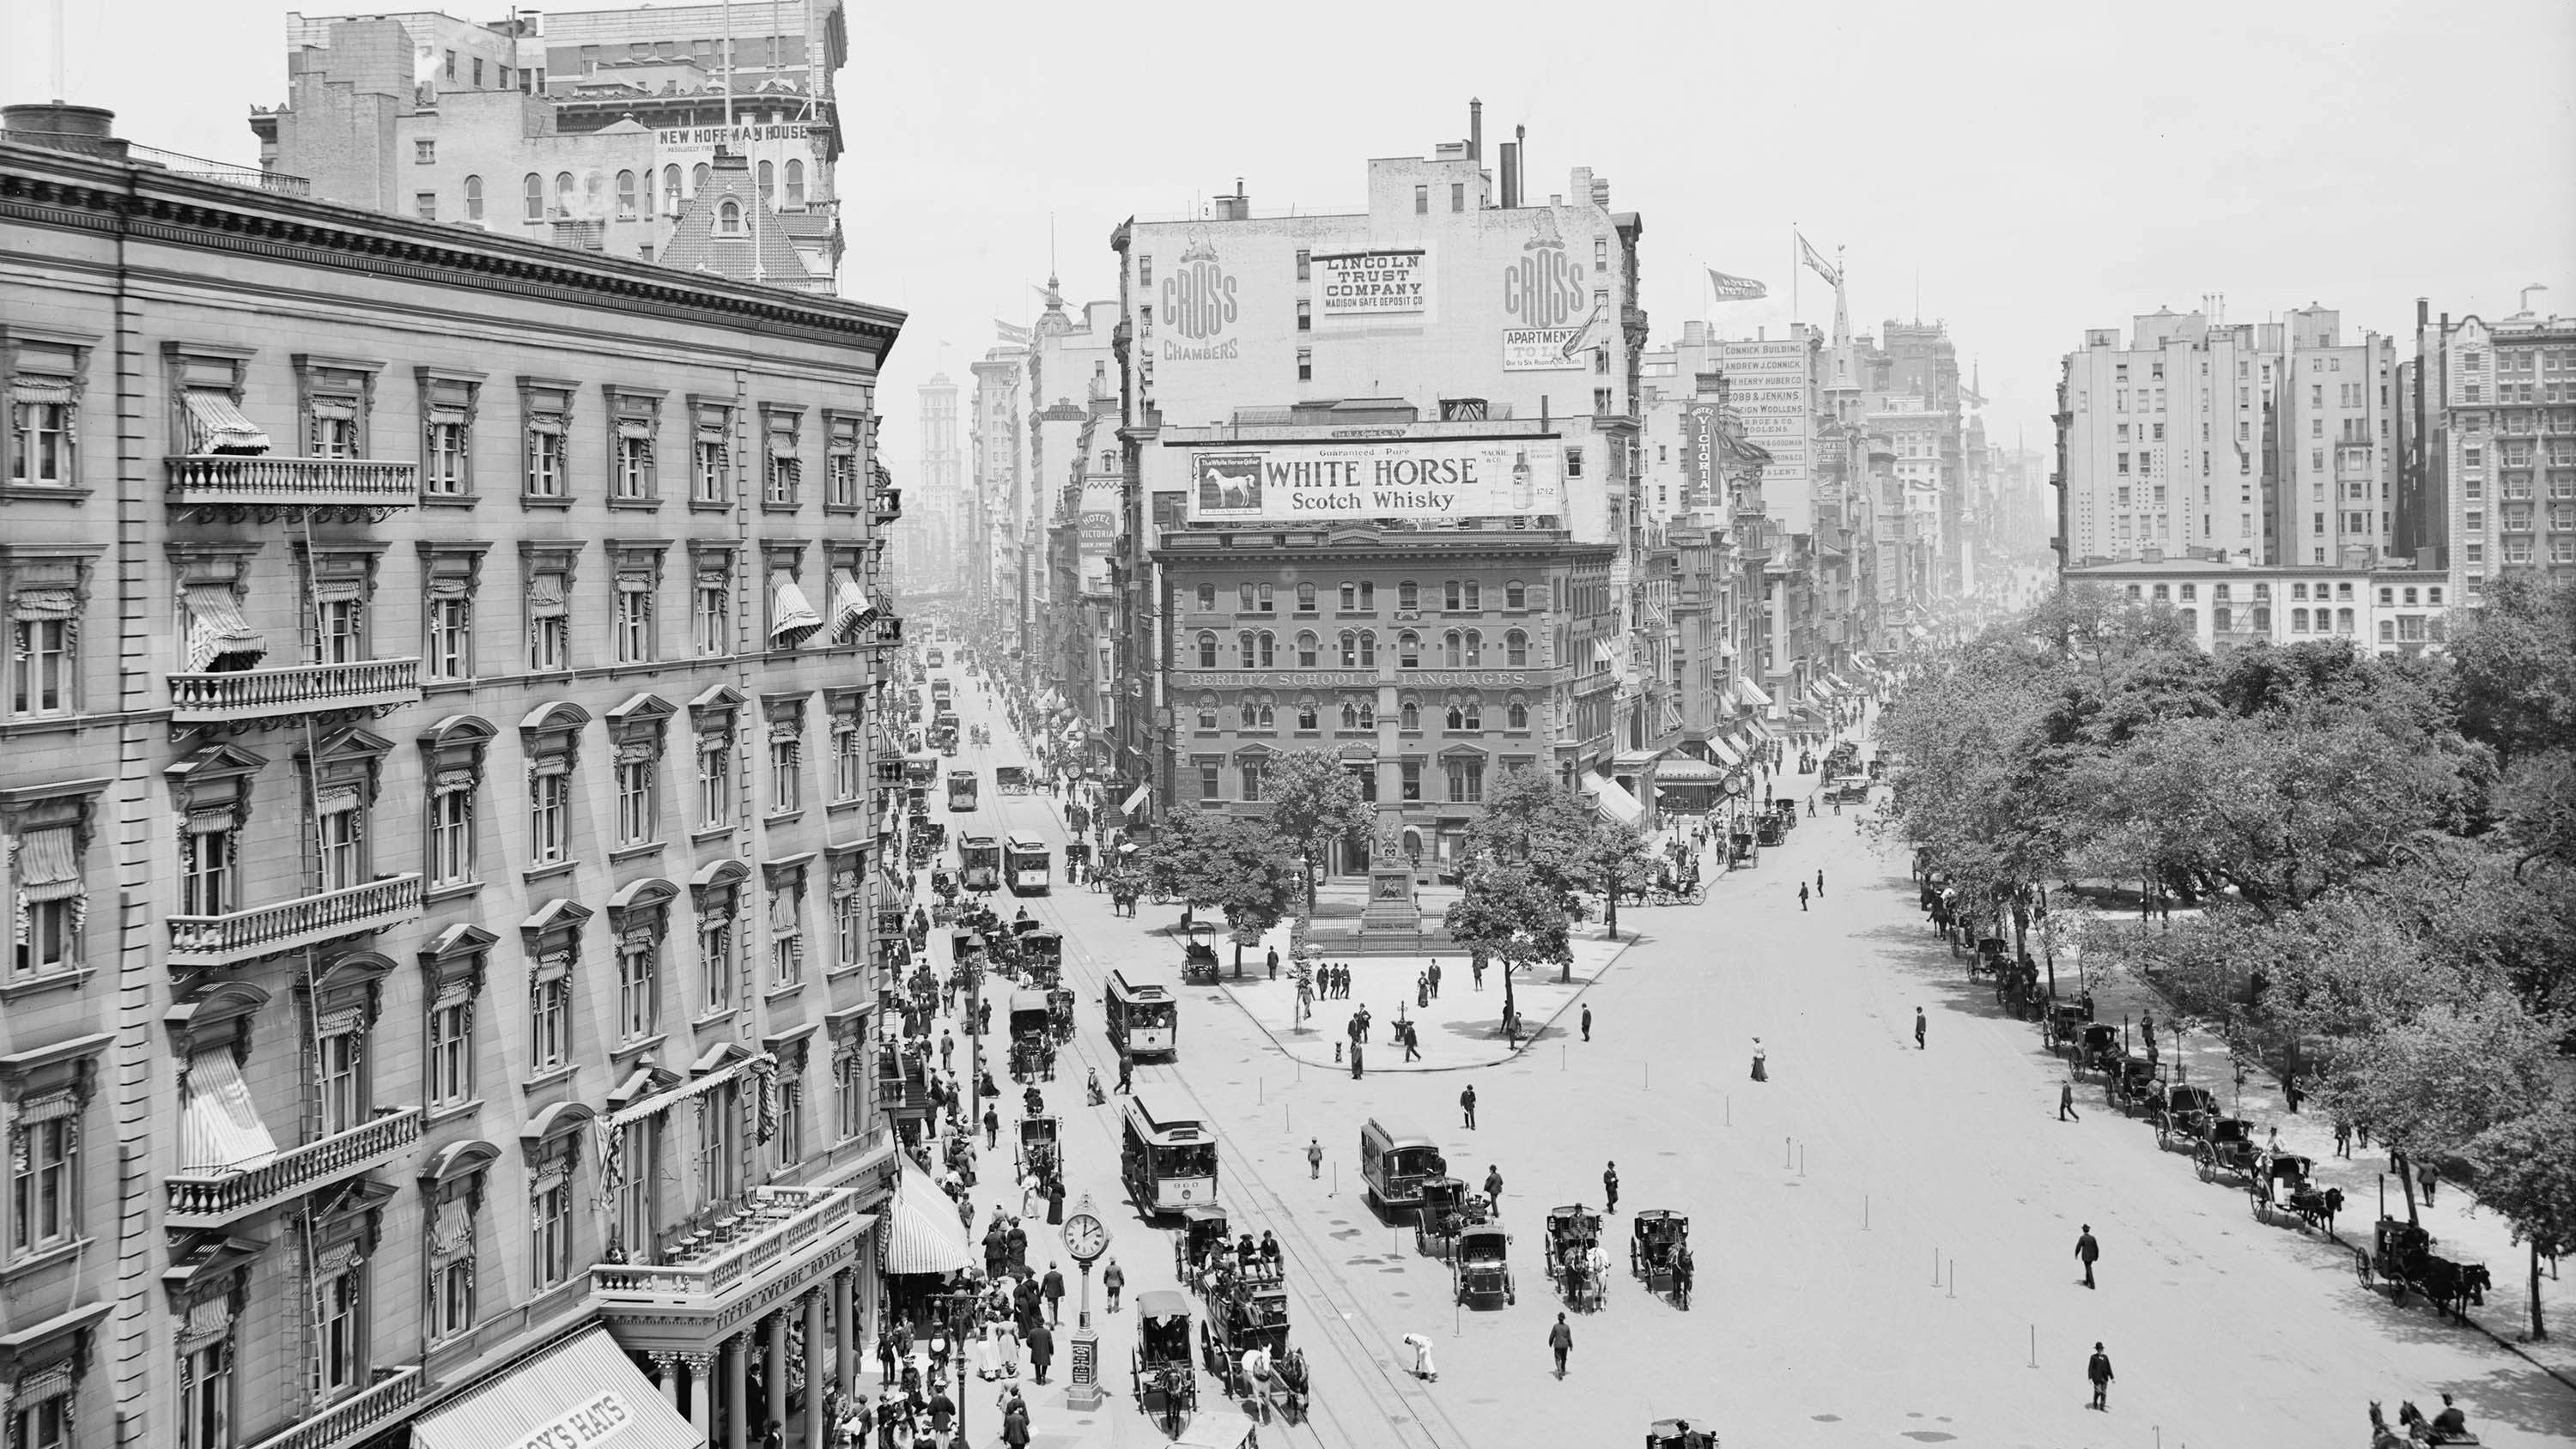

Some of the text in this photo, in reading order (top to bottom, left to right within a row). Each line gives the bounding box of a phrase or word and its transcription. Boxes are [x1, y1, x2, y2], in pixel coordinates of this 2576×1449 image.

[660, 125, 807, 144] NEW HOFFMAN HOUSE
[1327, 256, 1420, 270] LINCOLN
[1338, 269, 1410, 283] TRUST
[1327, 282, 1422, 297] COMPANY
[1504, 248, 1584, 328] CROSS
[1162, 260, 1237, 340] CROSS
[1326, 298, 1357, 308] MADISON
[1359, 297, 1378, 306] SAFE
[1380, 296, 1411, 306] DEPOSIT
[1507, 330, 1577, 344] APARTMENT
[1163, 337, 1238, 361] CHAMBERS
[1515, 346, 1536, 357] TO
[1725, 345, 1759, 355] CONNICK
[1739, 377, 1764, 385] HENRY
[1765, 376, 1790, 385] HUBER
[1753, 391, 1759, 401] &
[1760, 404, 1802, 413] WOOLLENS
[1319, 447, 1411, 457] Guaranteed Pure
[1266, 458, 1479, 488] WHITE HORSE
[1292, 489, 1455, 512] Scotch Whisky
[1082, 514, 1110, 525] HOTEL
[1080, 530, 1115, 538] VICTORIA
[1189, 673, 1268, 686] BERLITZ
[1279, 674, 1361, 686] SCHOOL
[1401, 672, 1531, 686] LANGUAGES.
[716, 1300, 752, 1330] FIFTH
[761, 1270, 804, 1304] AVENUE
[568, 1395, 626, 1442] HATS
